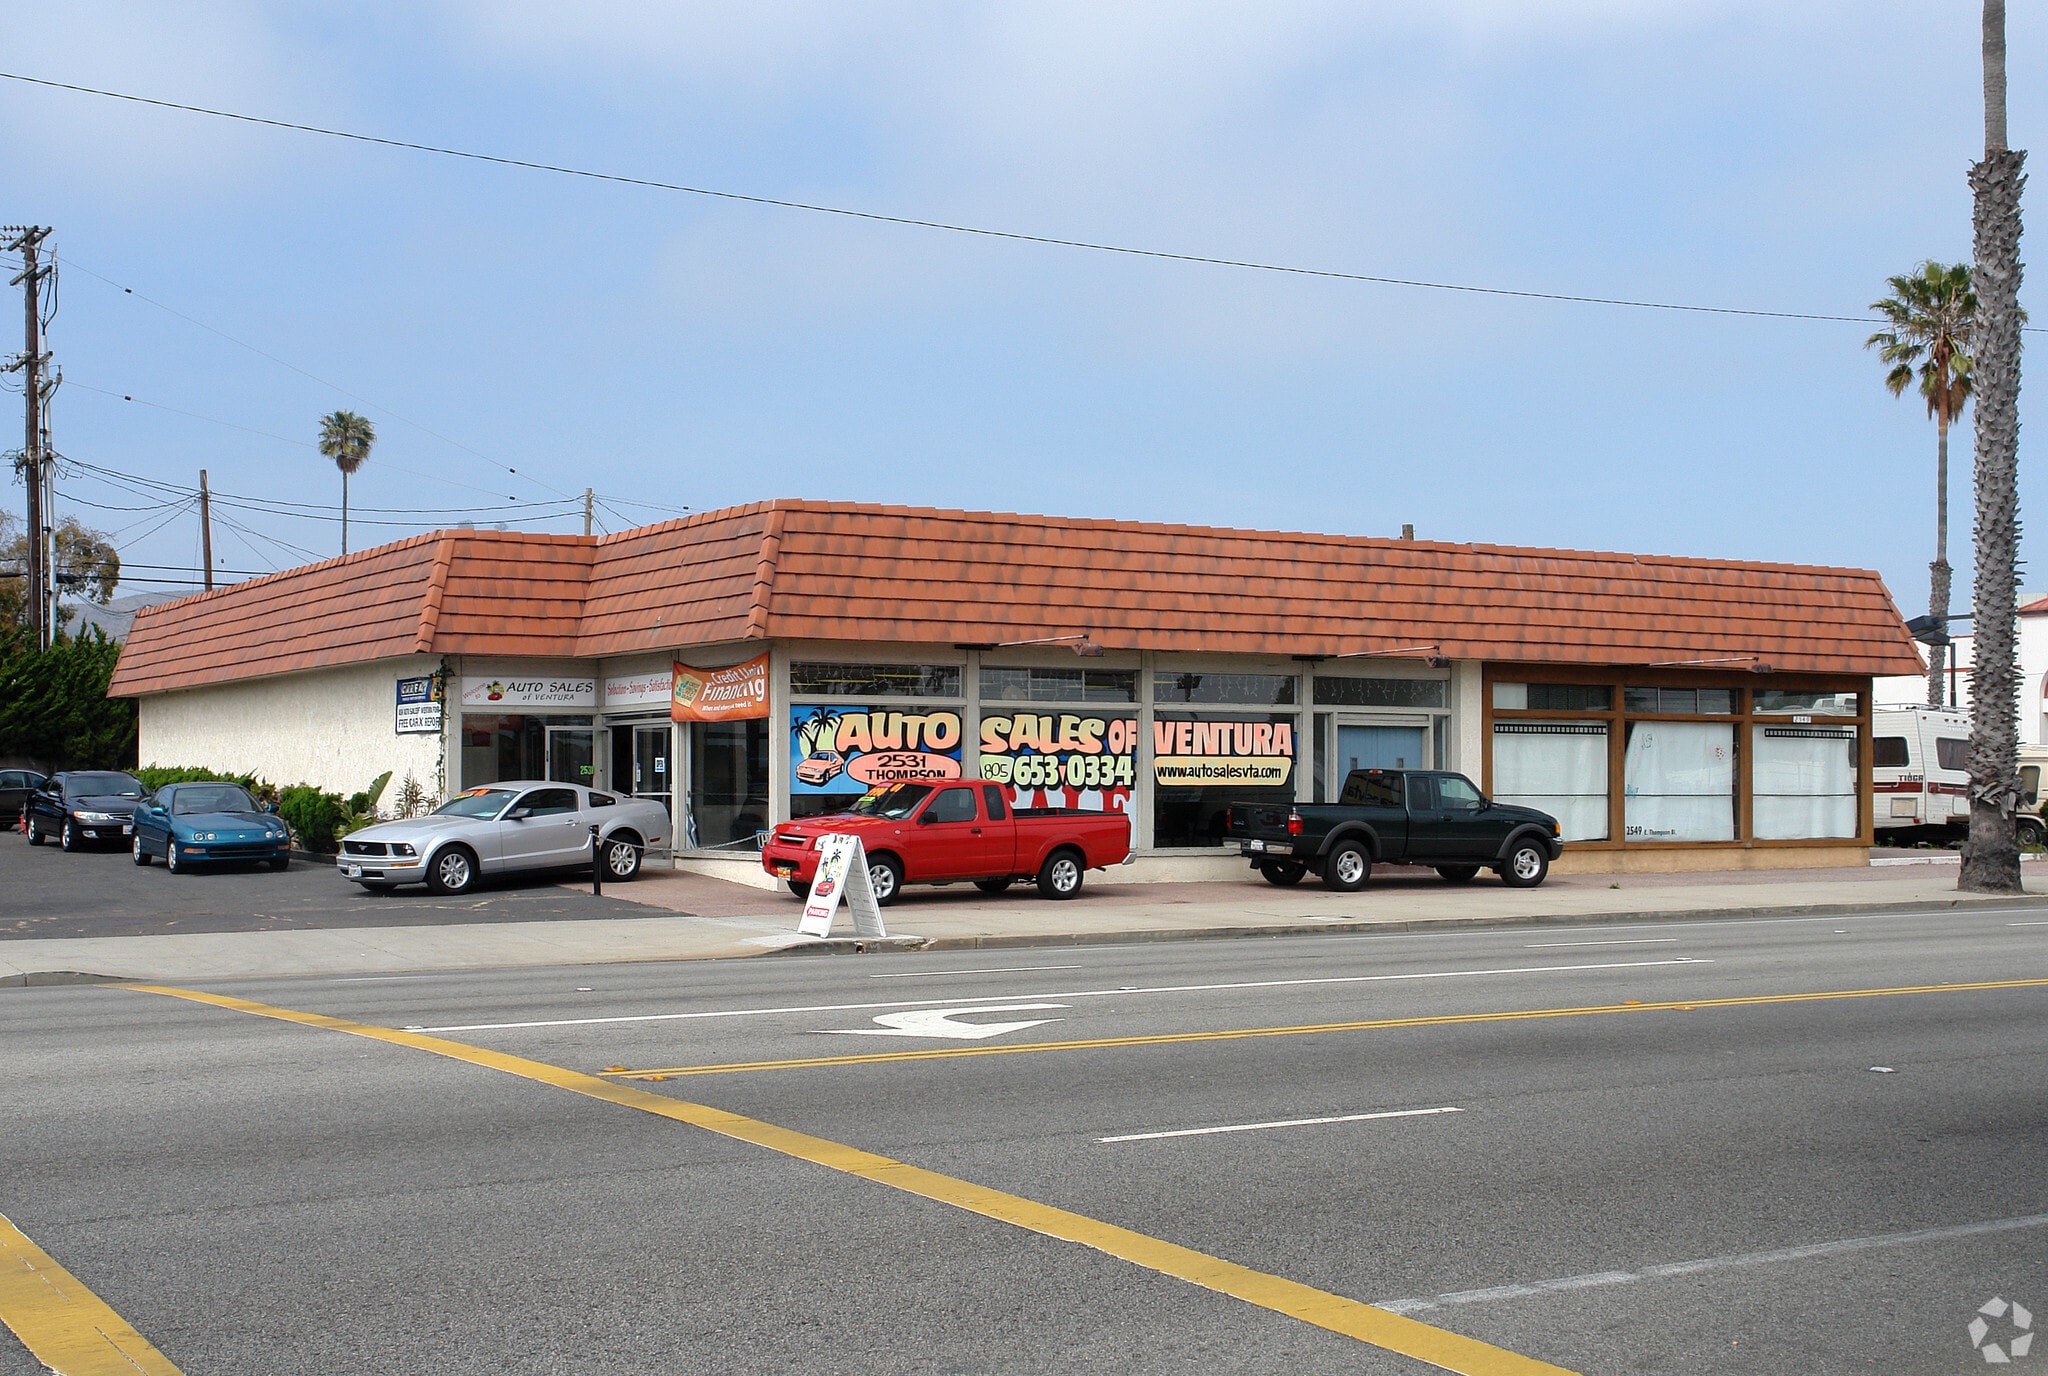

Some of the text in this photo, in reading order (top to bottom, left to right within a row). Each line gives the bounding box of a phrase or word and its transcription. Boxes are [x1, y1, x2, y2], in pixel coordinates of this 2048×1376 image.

[711, 669, 742, 684] Credit
[462, 682, 487, 699] Welcome
[506, 681, 593, 693] AUTO SALES
[522, 693, 575, 701] of VENTURA
[834, 711, 1293, 756] AUTO SALES OF VENTURA
[877, 755, 927, 768] 2531
[865, 769, 946, 780] THOMPSON
[984, 753, 1135, 787] 805 653 0334
[1157, 763, 1281, 779] www.autosalesvta.com
[1626, 825, 1642, 836] 2549
